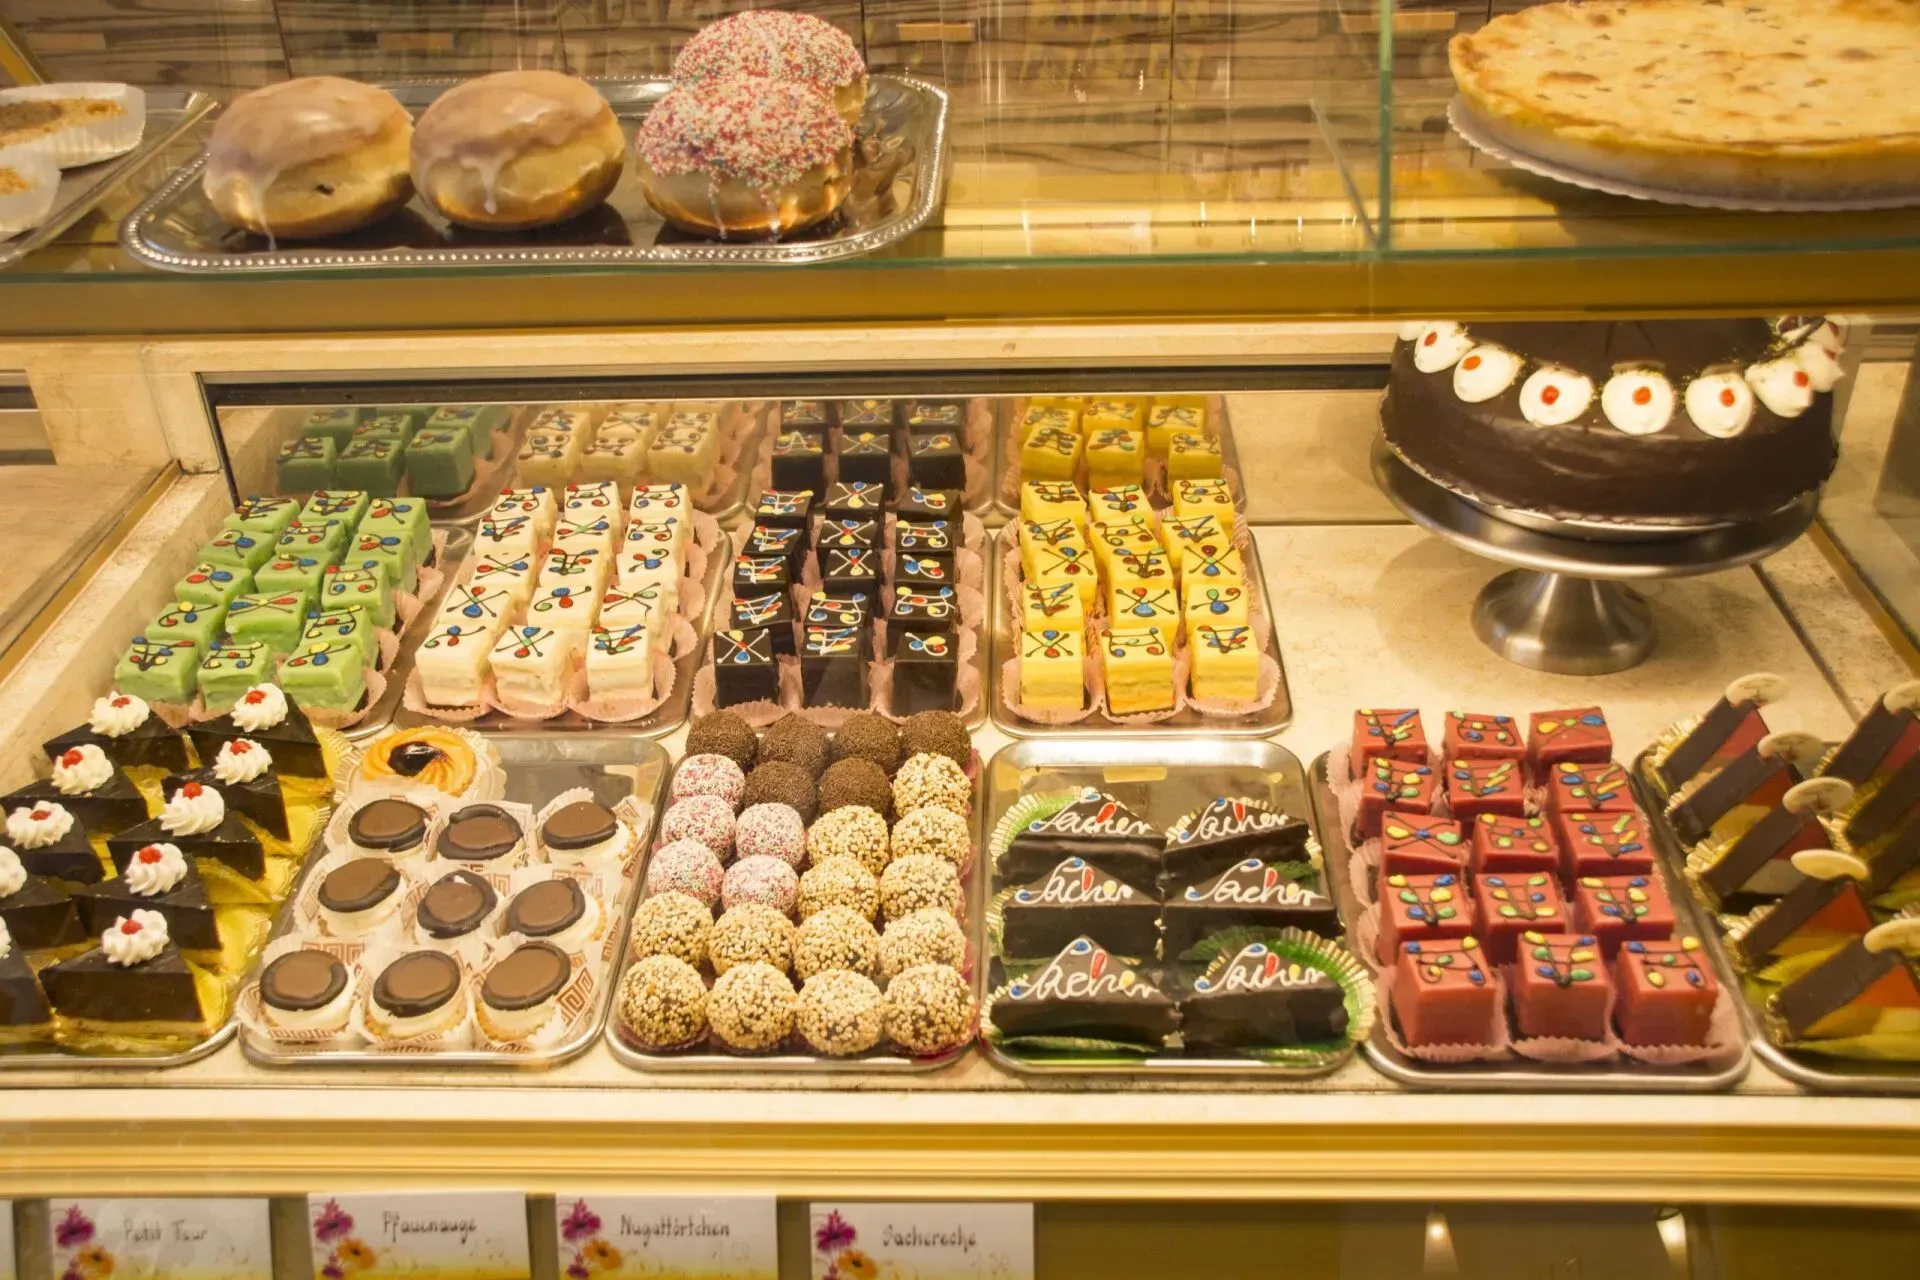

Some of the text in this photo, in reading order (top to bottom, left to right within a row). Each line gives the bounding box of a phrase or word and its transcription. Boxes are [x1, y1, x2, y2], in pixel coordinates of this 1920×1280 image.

[1177, 797, 1289, 843] Sacher
[1015, 856, 1133, 904] Sacher
[1184, 858, 1327, 906] Sacher
[1194, 943, 1325, 993] Sacher
[382, 1211, 477, 1245] Pfauenauge
